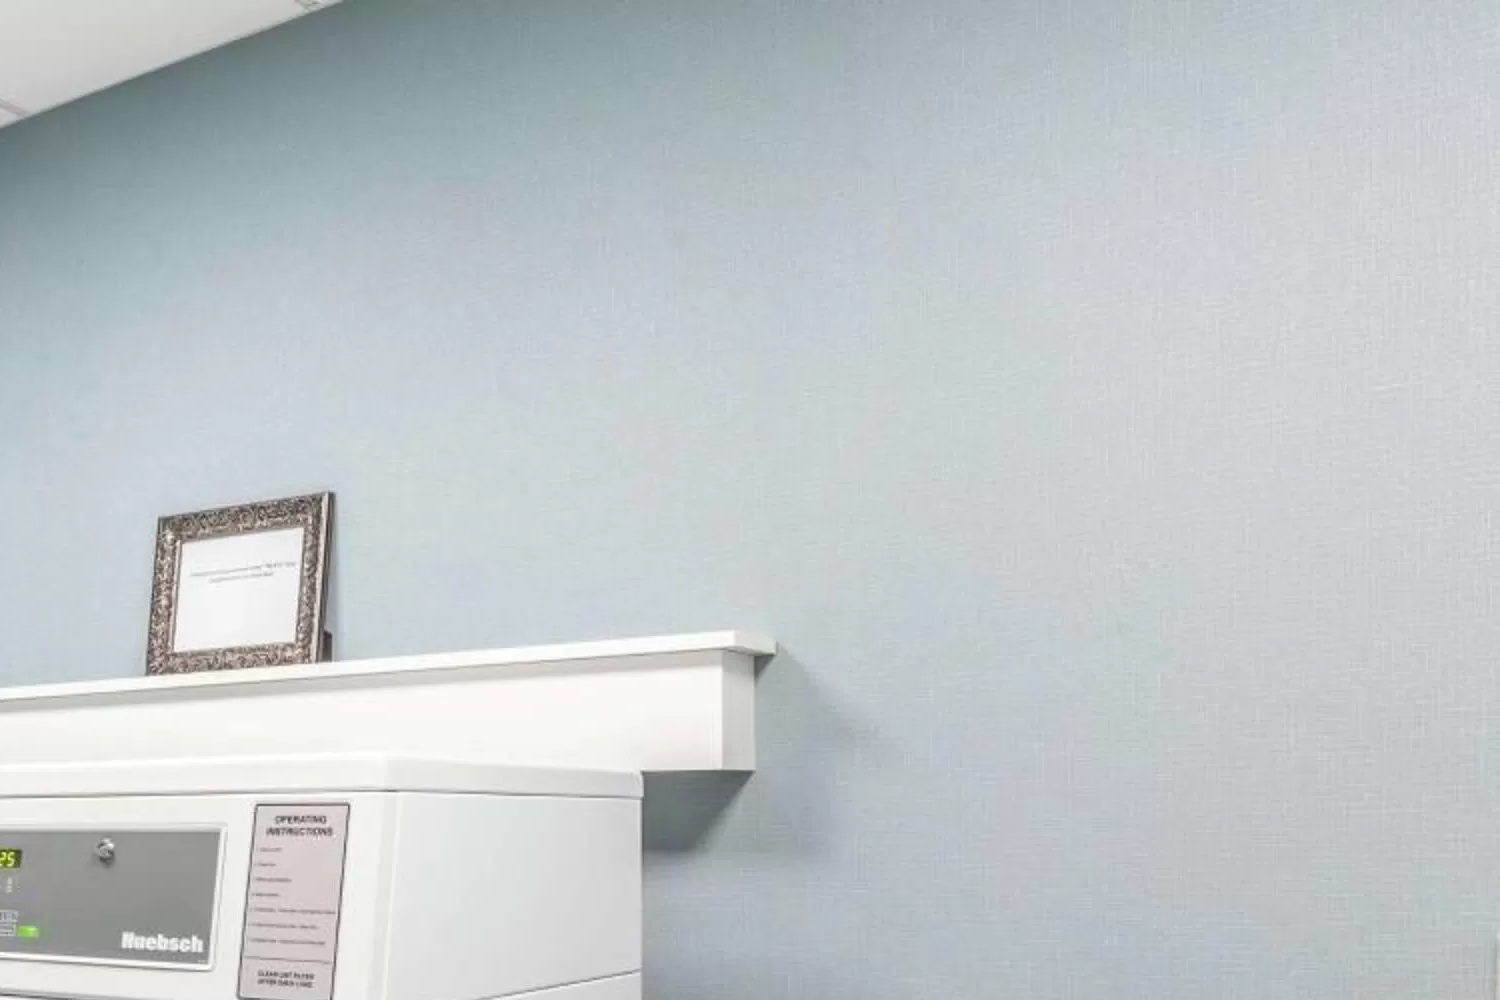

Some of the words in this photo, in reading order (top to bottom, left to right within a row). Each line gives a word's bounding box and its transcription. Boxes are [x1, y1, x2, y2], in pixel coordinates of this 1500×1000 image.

[274, 815, 327, 825] OPERATING
[266, 827, 333, 837] INSTRUCTIONS
[121, 931, 204, 953] Huebsch
